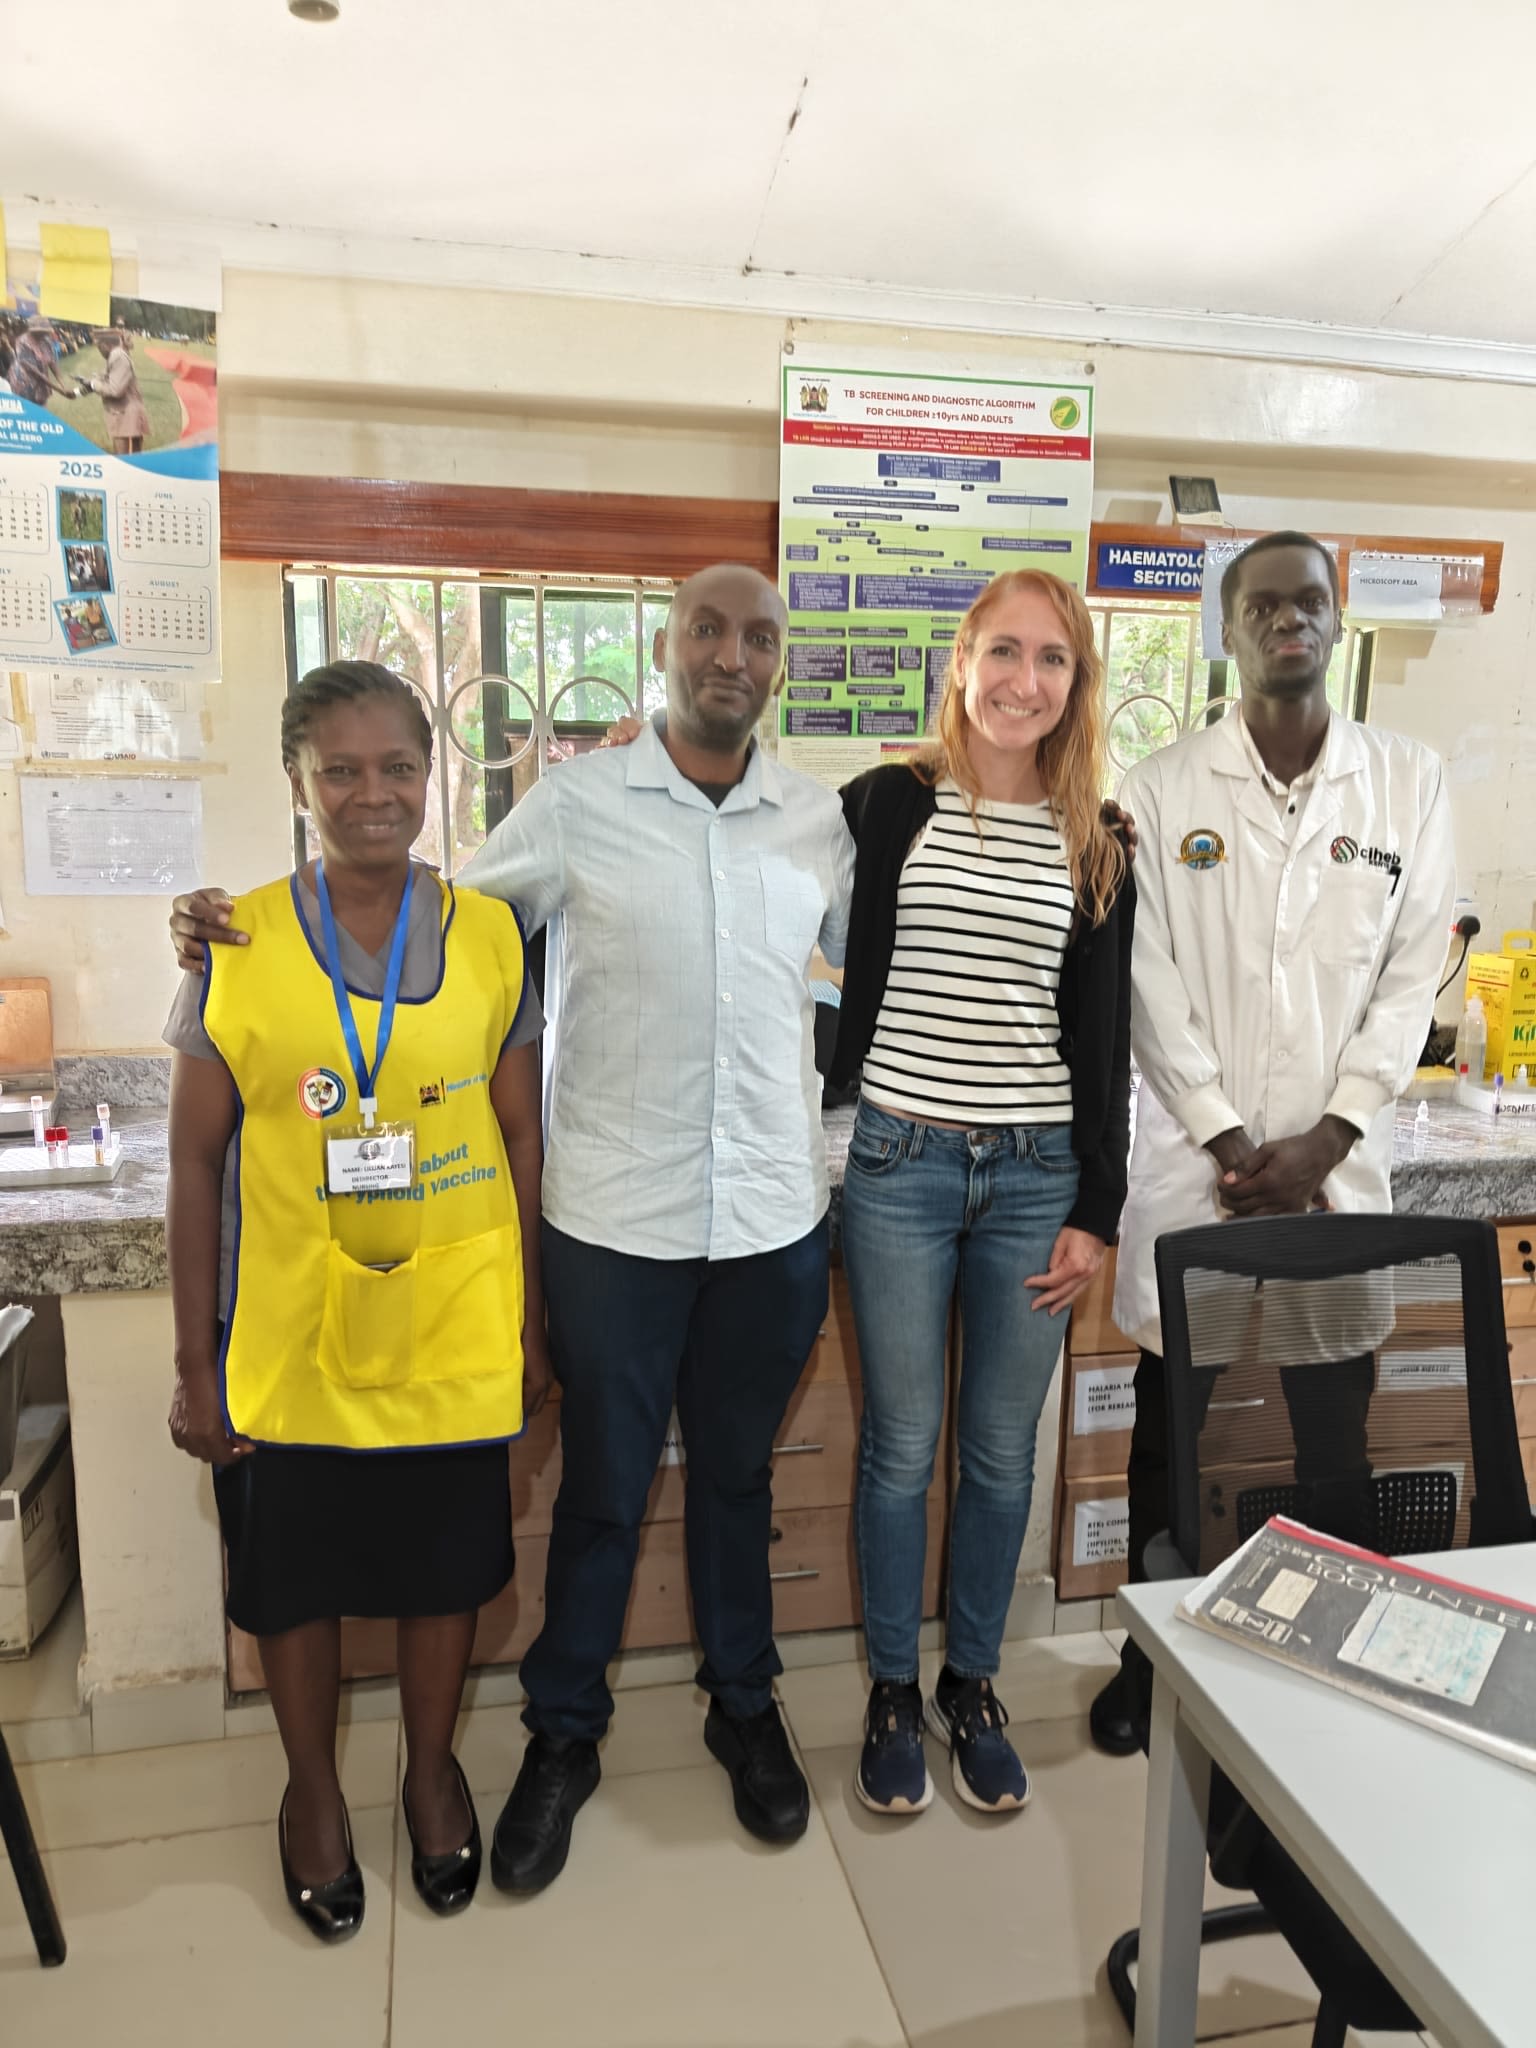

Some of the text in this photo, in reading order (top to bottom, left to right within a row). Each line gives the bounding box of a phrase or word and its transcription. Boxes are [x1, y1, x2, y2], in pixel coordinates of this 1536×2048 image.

[844, 389, 1036, 410] TB SCREENING AND DIAGNOSTIC ALGORITHM
[866, 407, 884, 416] FOR
[886, 408, 930, 419] CHILDREN
[961, 414, 979, 422] AND
[980, 415, 1014, 424] ADULTS
[16, 420, 38, 432] THE
[40, 423, 64, 435] OLD
[60, 460, 103, 479] 2025
[1109, 548, 1204, 568] HAEMATOLO
[1133, 569, 1202, 587] SECTION
[1360, 578, 1418, 586] MICROSCOPY AREA
[419, 1144, 470, 1174] about
[1306, 1562, 1378, 1595] BOO
